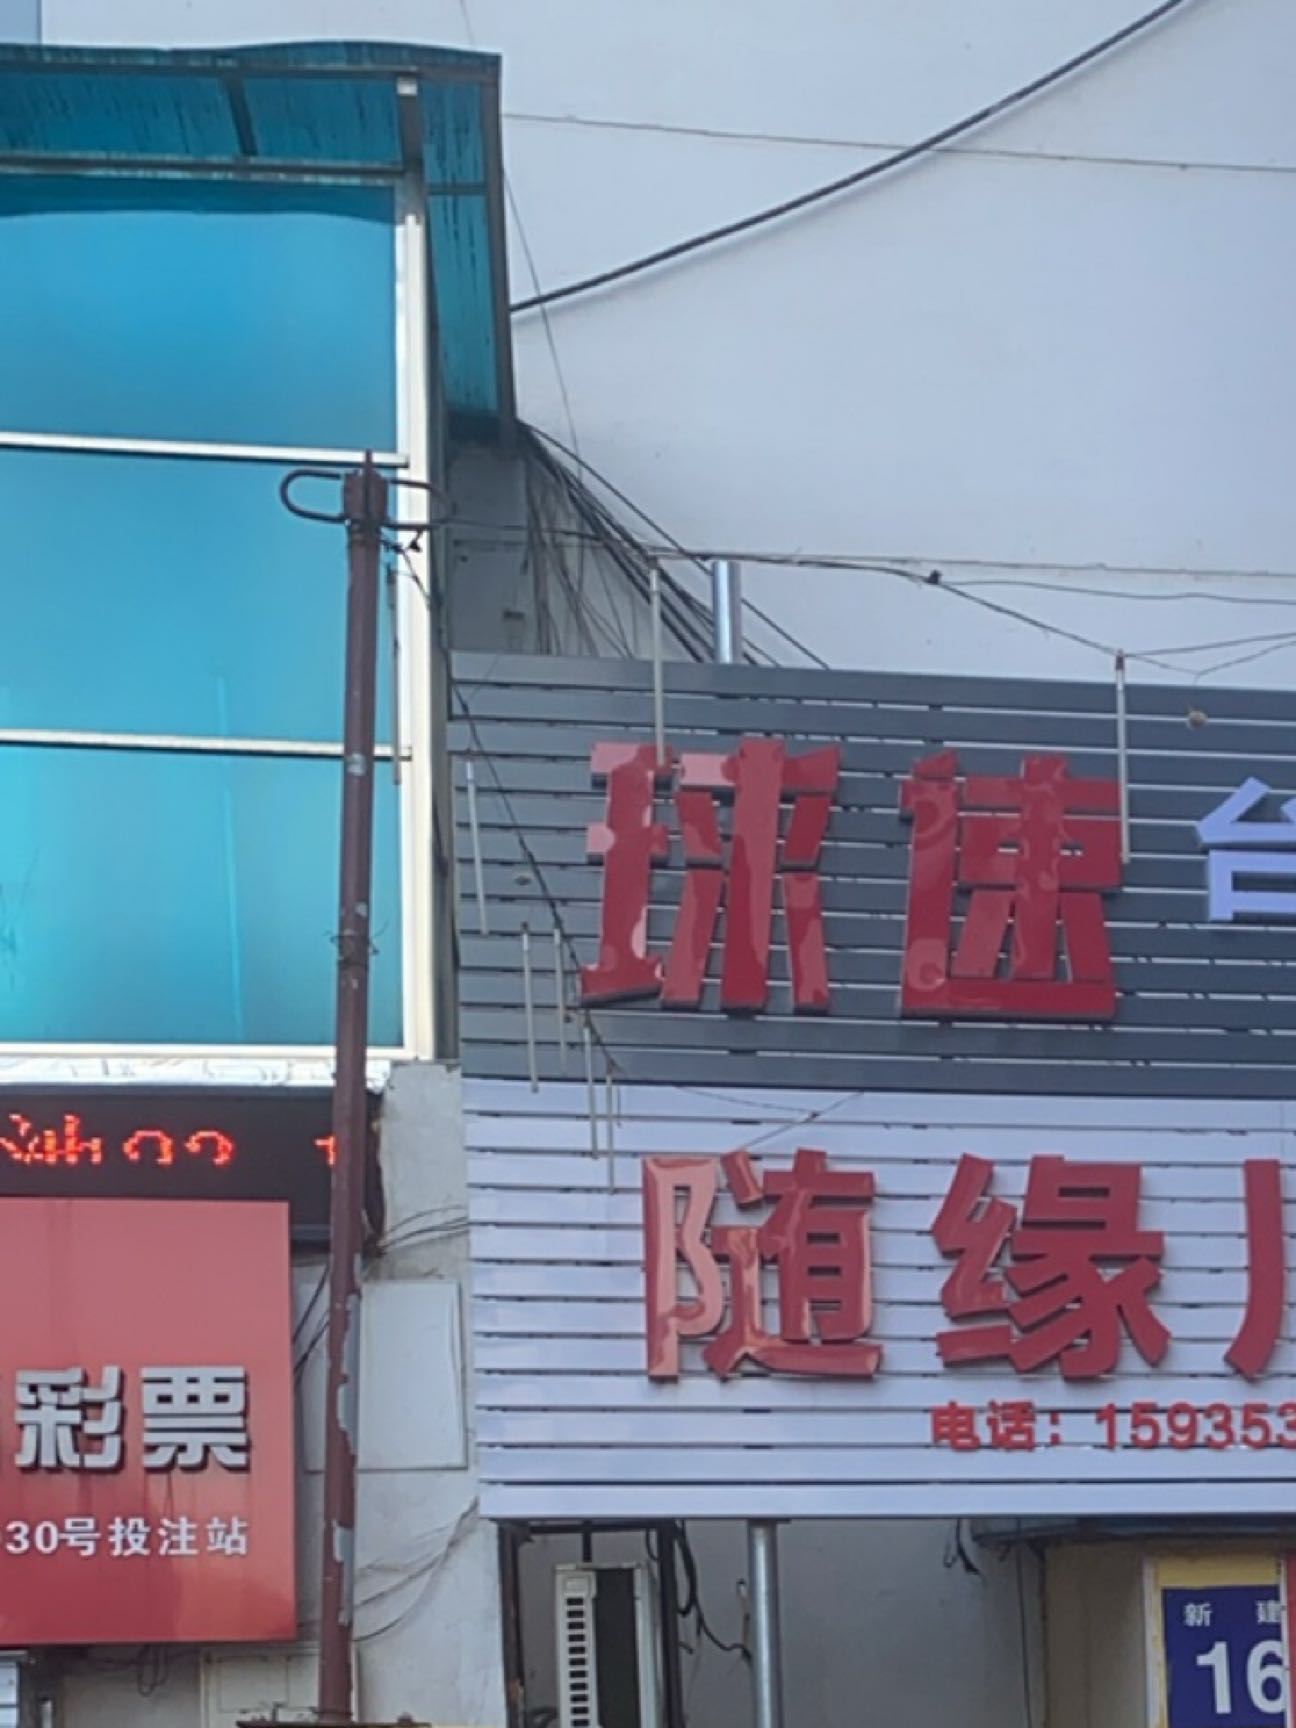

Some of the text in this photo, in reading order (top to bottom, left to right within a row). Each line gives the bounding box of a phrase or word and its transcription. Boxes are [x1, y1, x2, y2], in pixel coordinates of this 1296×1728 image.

[15, 1365, 251, 1472] 彩票
[0, 1516, 248, 1556] 30号投注站
[1196, 1640, 1286, 1715] 16
